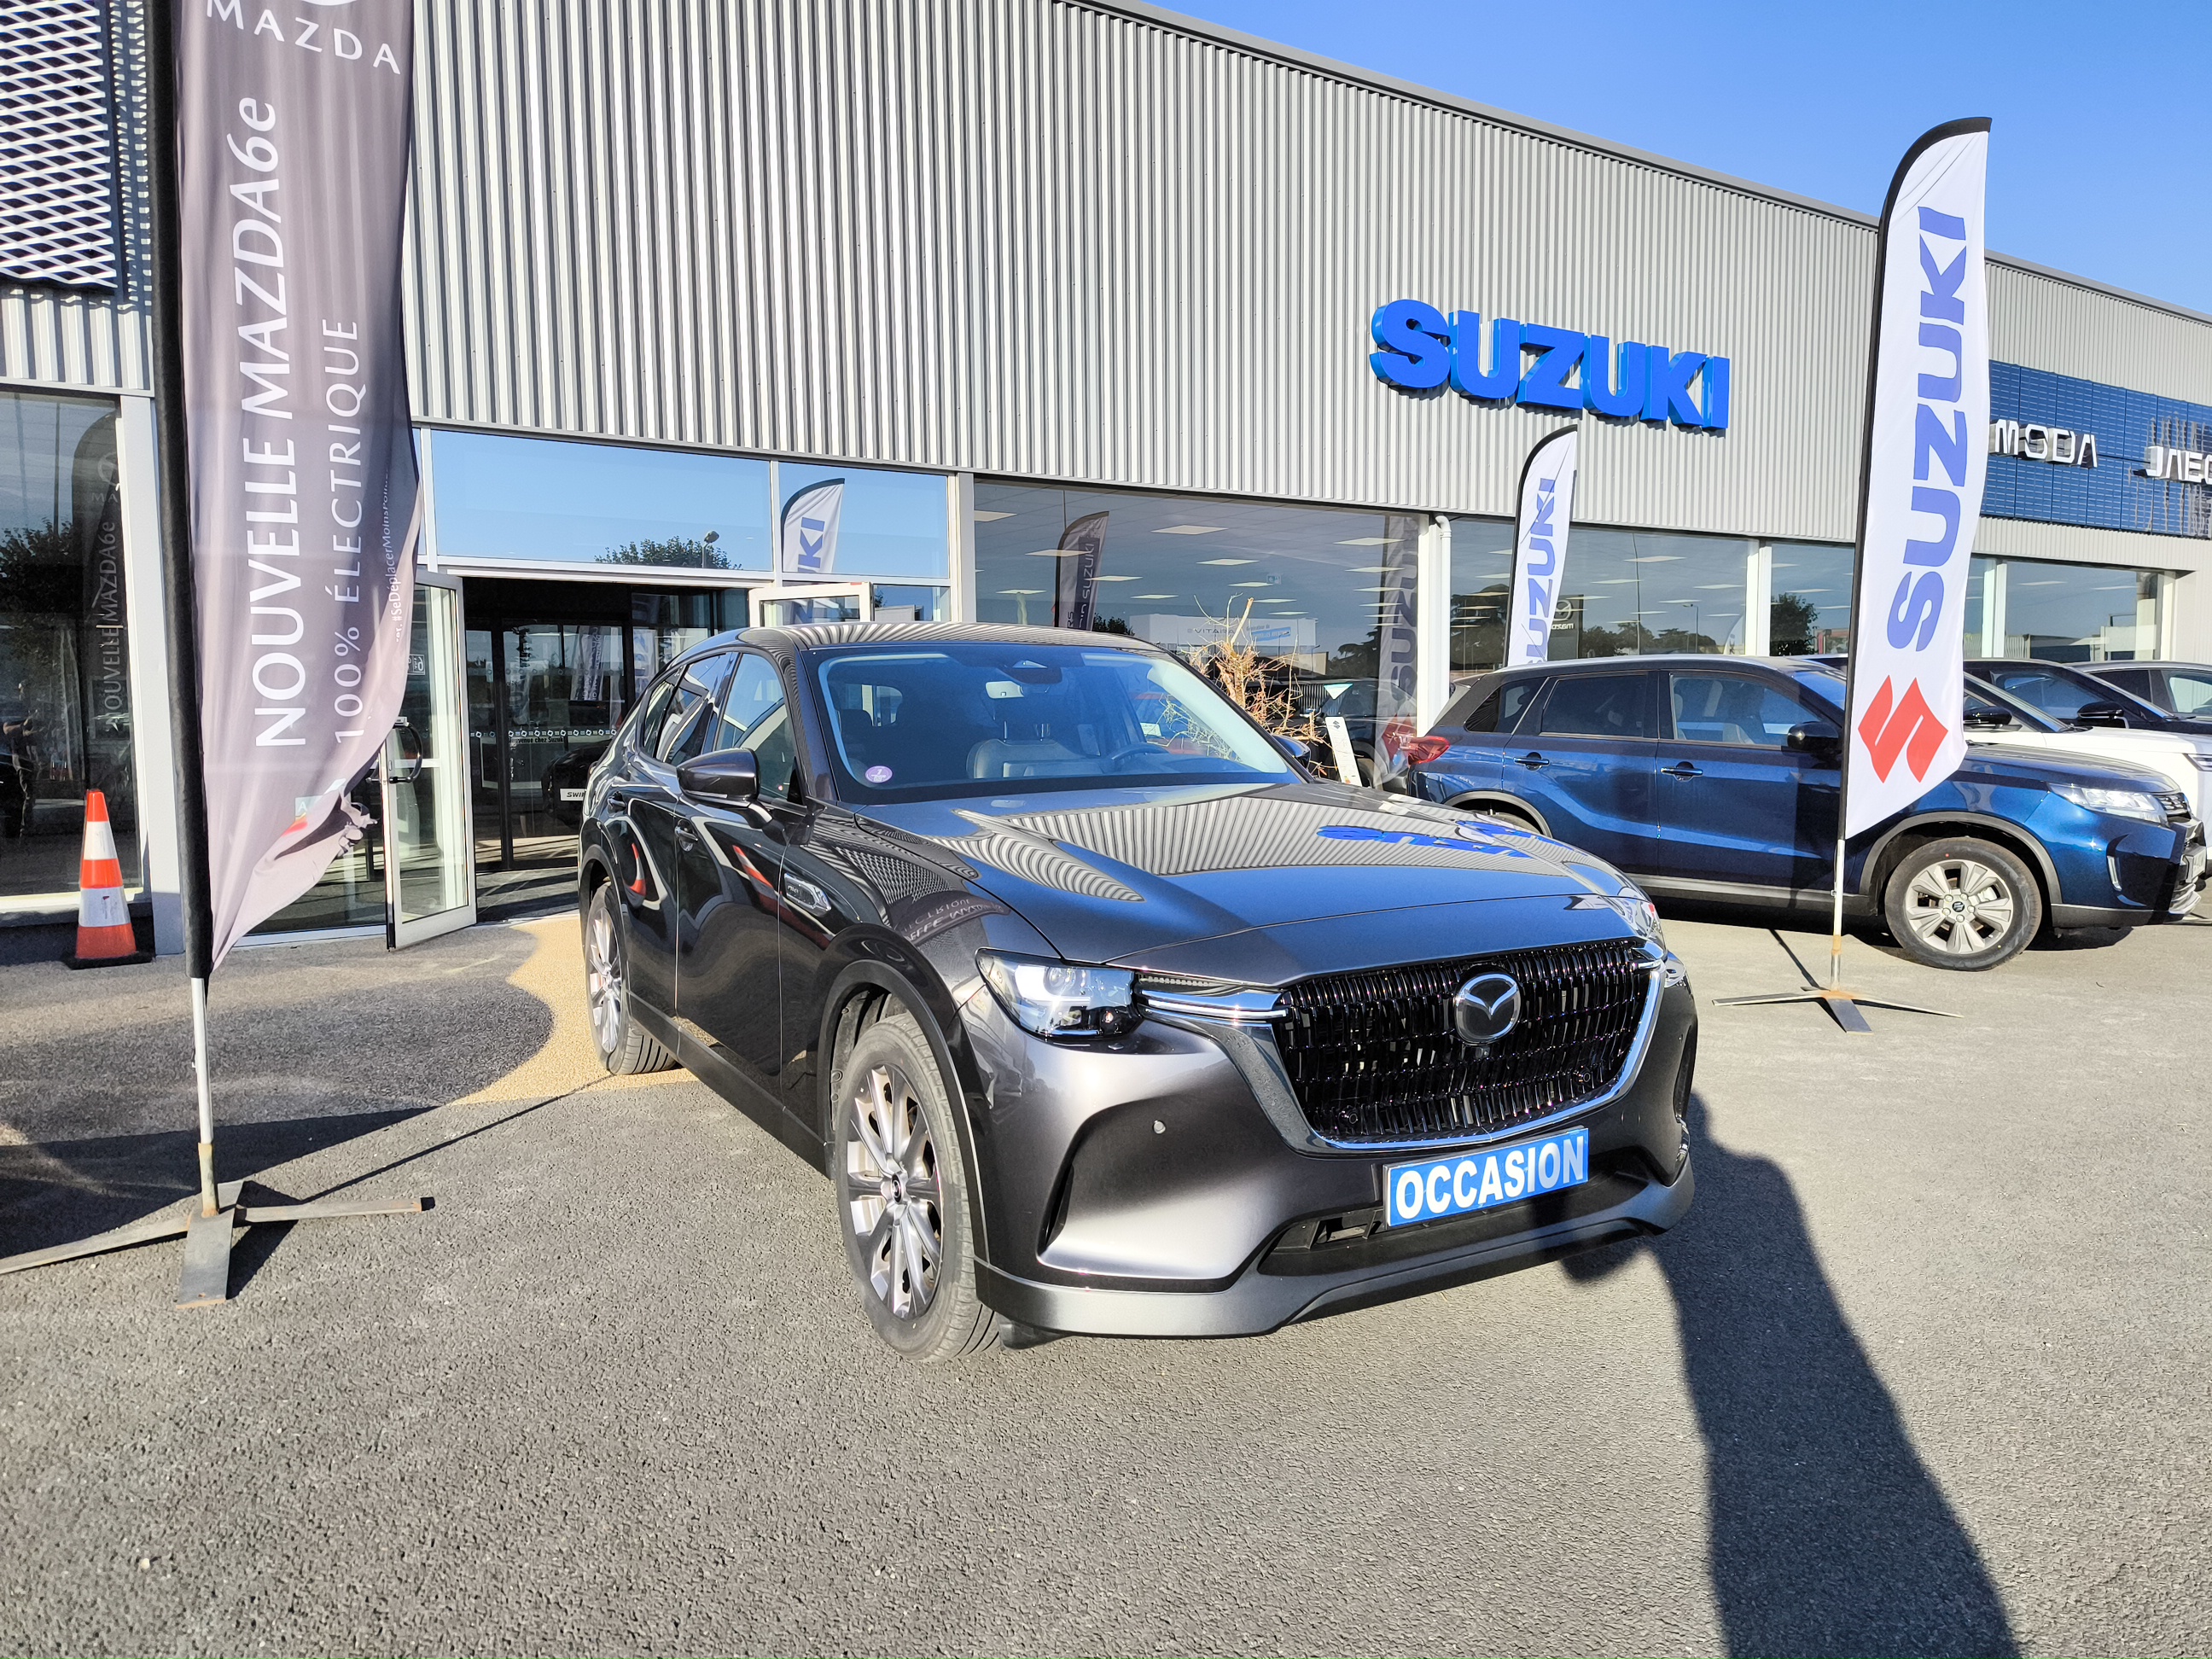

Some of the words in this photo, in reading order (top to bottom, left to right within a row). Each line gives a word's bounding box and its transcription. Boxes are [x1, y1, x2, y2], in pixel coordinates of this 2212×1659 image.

[207, 0, 401, 75] MAZDA
[226, 96, 293, 420] MAZDA6e
[1370, 299, 1730, 429] SUZUKI
[1886, 206, 1968, 651] SUZUKI
[322, 318, 367, 603] ÉLECTRIQUE
[242, 437, 306, 747] NOUVELLE
[1526, 477, 1556, 663] UZUKI
[334, 626, 364, 744] 100%
[1395, 1135, 1584, 1220] OCCASION
